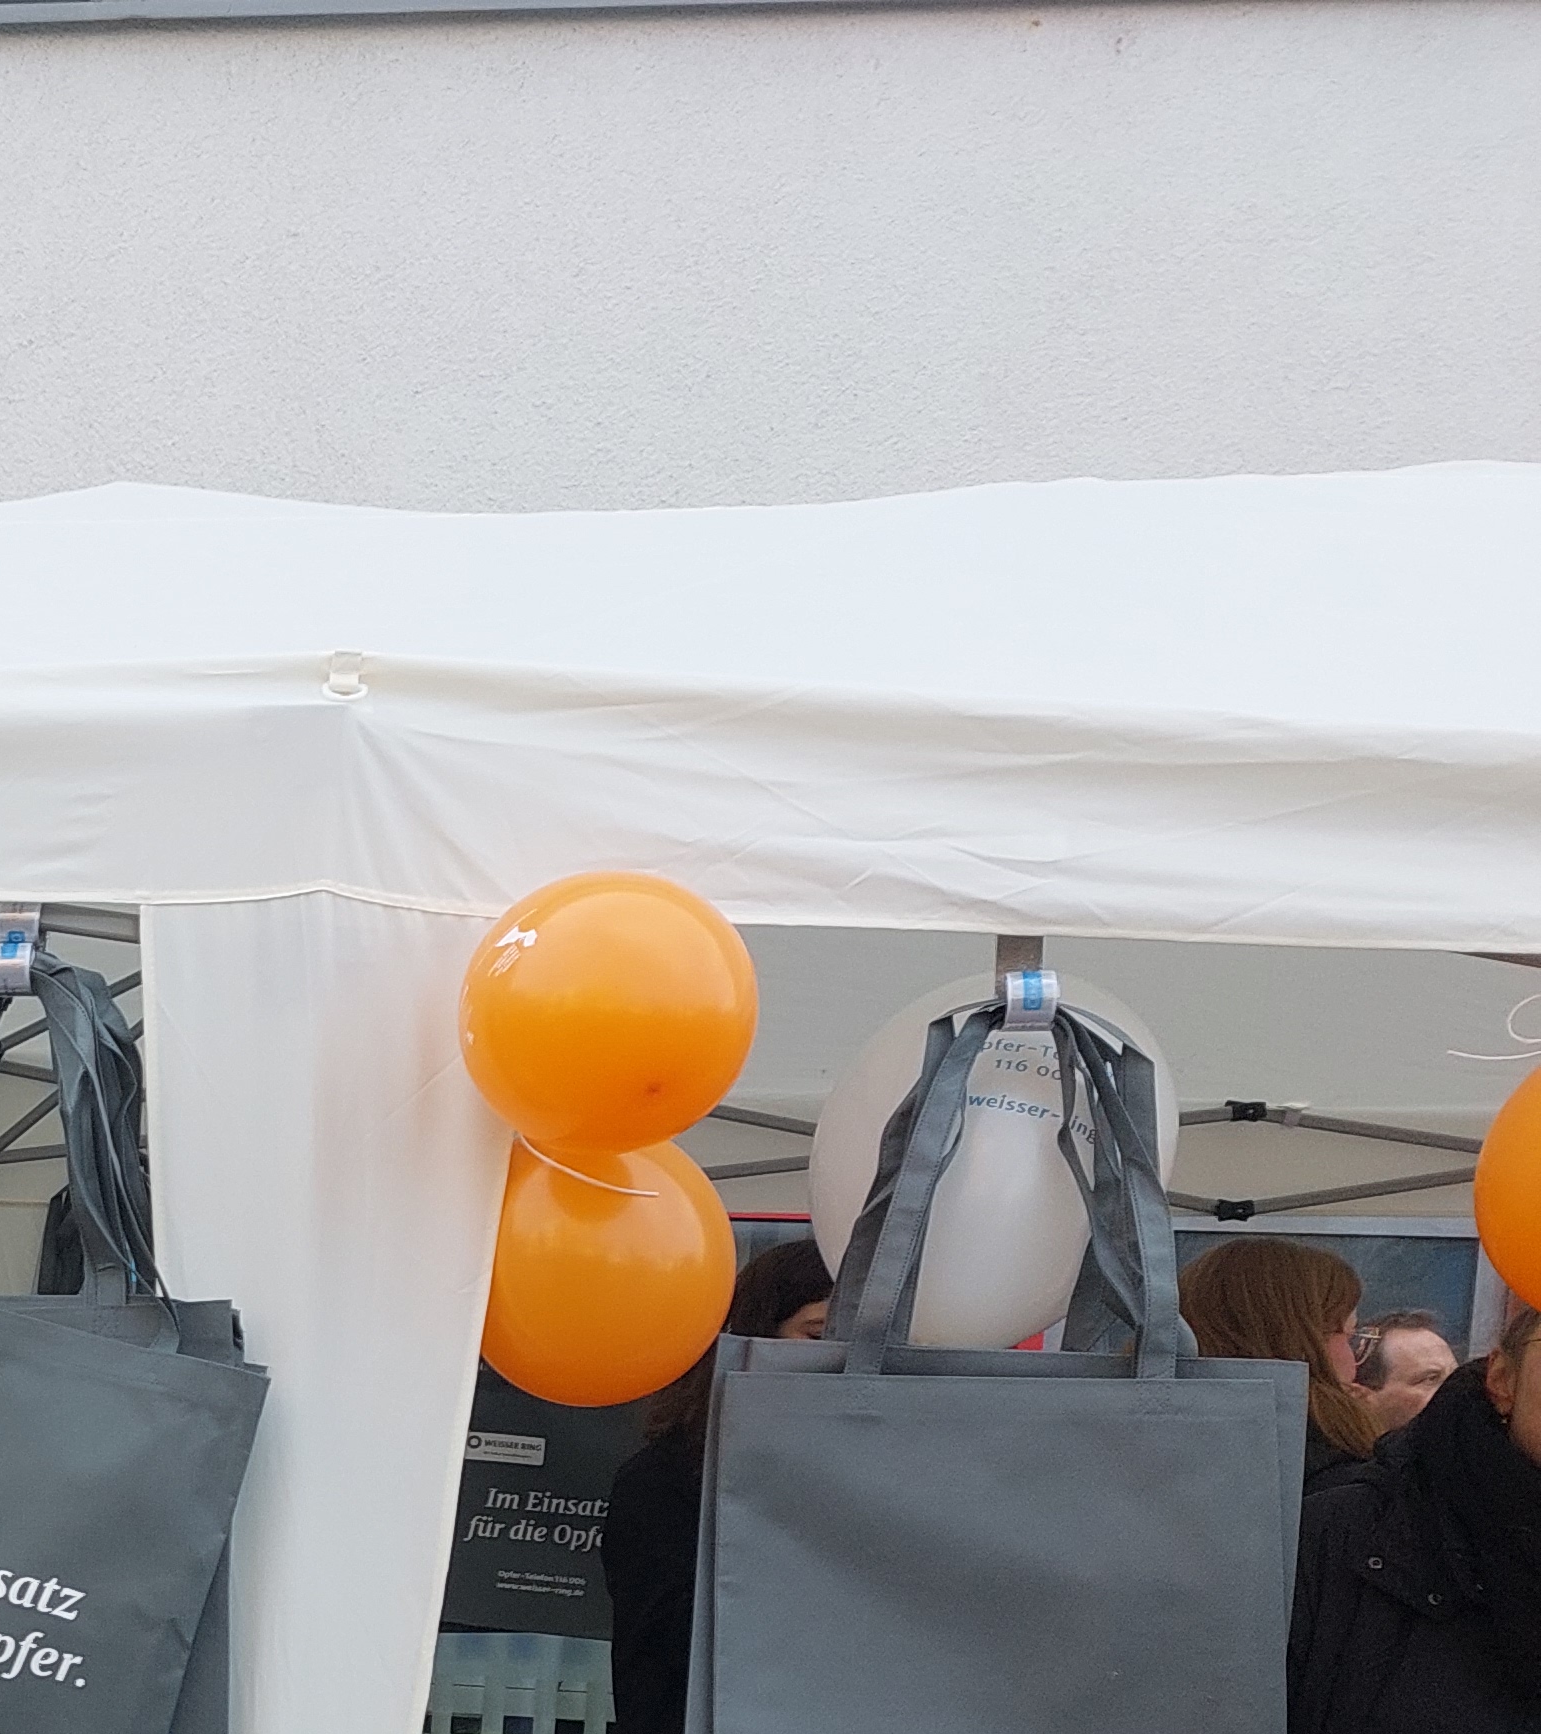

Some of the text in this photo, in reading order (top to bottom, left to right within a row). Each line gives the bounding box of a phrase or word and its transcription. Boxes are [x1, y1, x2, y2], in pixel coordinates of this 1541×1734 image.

[995, 1058, 1028, 1072] 116
[484, 1487, 519, 1510] Im
[463, 1515, 547, 1542] für die
